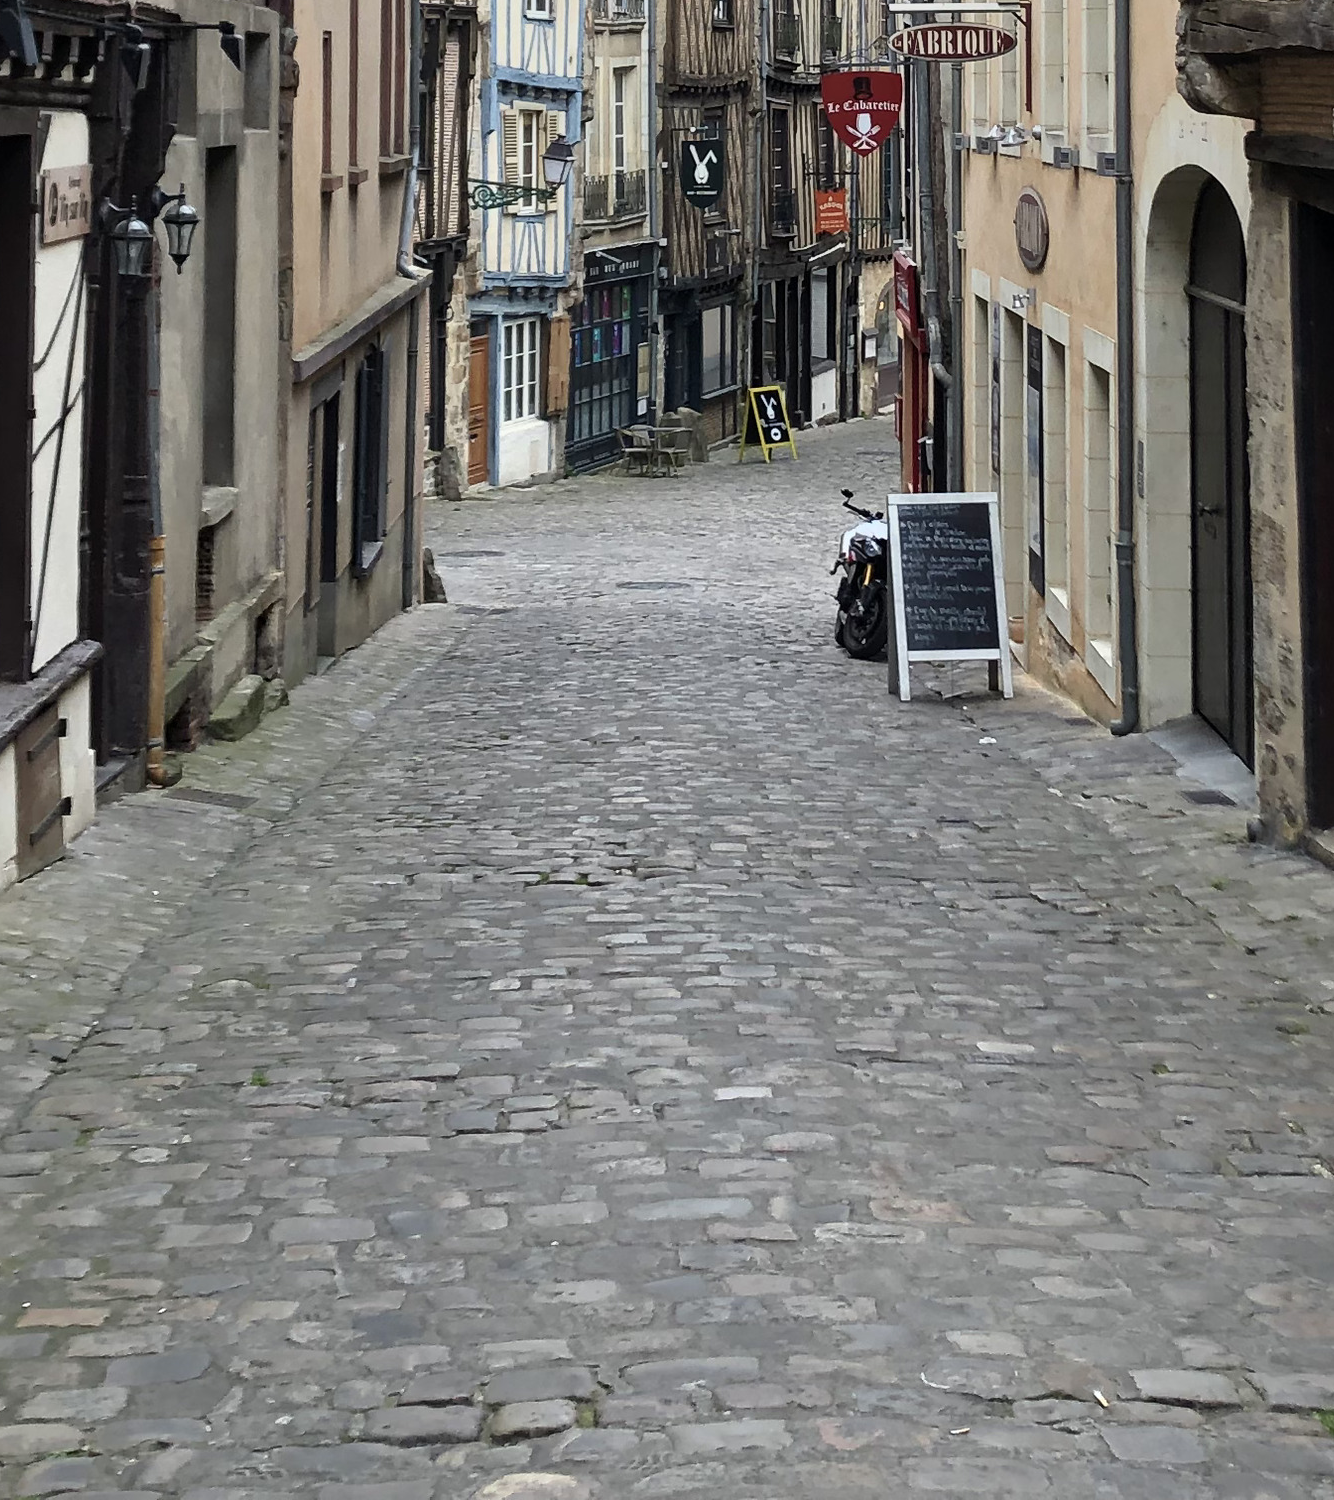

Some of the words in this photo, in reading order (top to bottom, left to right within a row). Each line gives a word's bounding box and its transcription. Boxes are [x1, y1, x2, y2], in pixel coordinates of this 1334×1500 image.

[903, 29, 1005, 56] FABRIQUE
[827, 102, 840, 114] Le
[843, 100, 899, 112] Cabaretier
